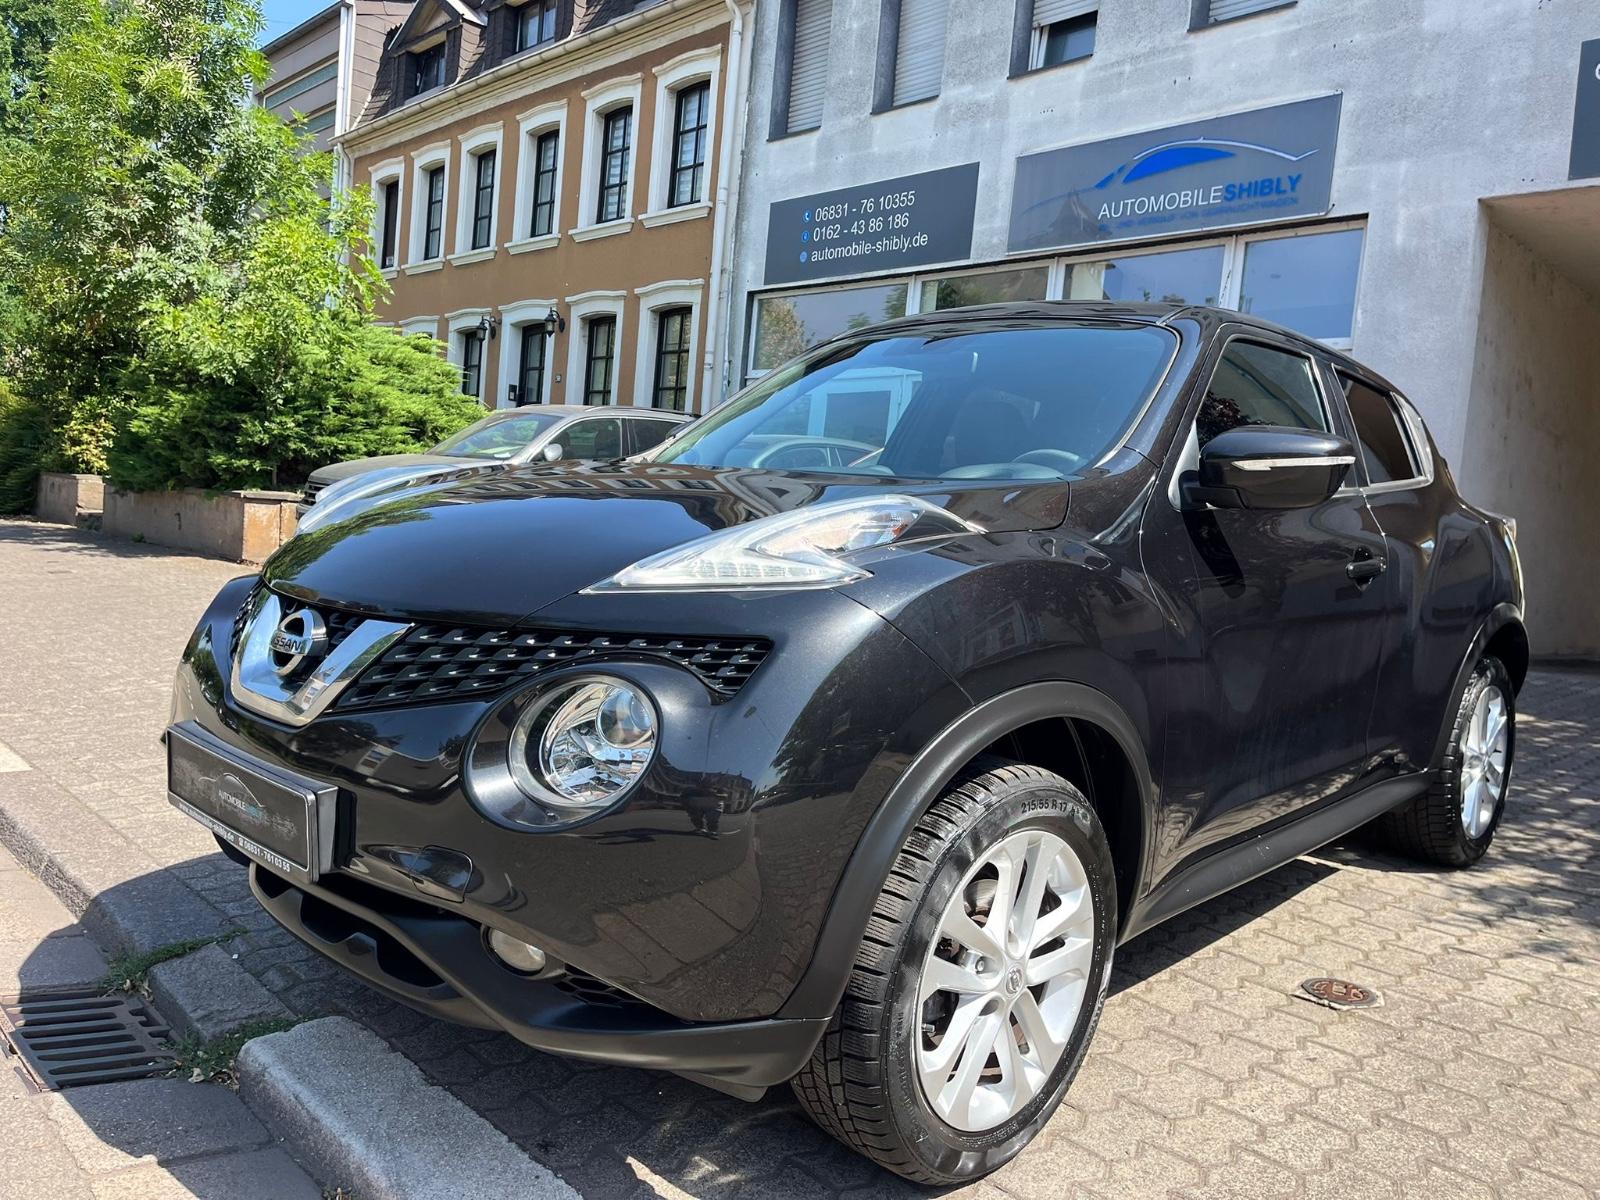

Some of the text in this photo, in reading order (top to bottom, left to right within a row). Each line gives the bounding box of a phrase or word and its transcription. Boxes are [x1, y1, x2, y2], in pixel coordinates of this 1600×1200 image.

[815, 202, 849, 222] 06831
[860, 198, 875, 214] 76
[879, 190, 916, 211] 10355
[813, 224, 841, 242] 0162
[851, 219, 866, 235] 43
[868, 217, 884, 233] 86
[887, 212, 910, 230] 186
[811, 231, 929, 262] automobile-shibly.de
[1021, 798, 1050, 814] 215/55
[1051, 798, 1058, 810] R
[1059, 801, 1068, 813] 17
